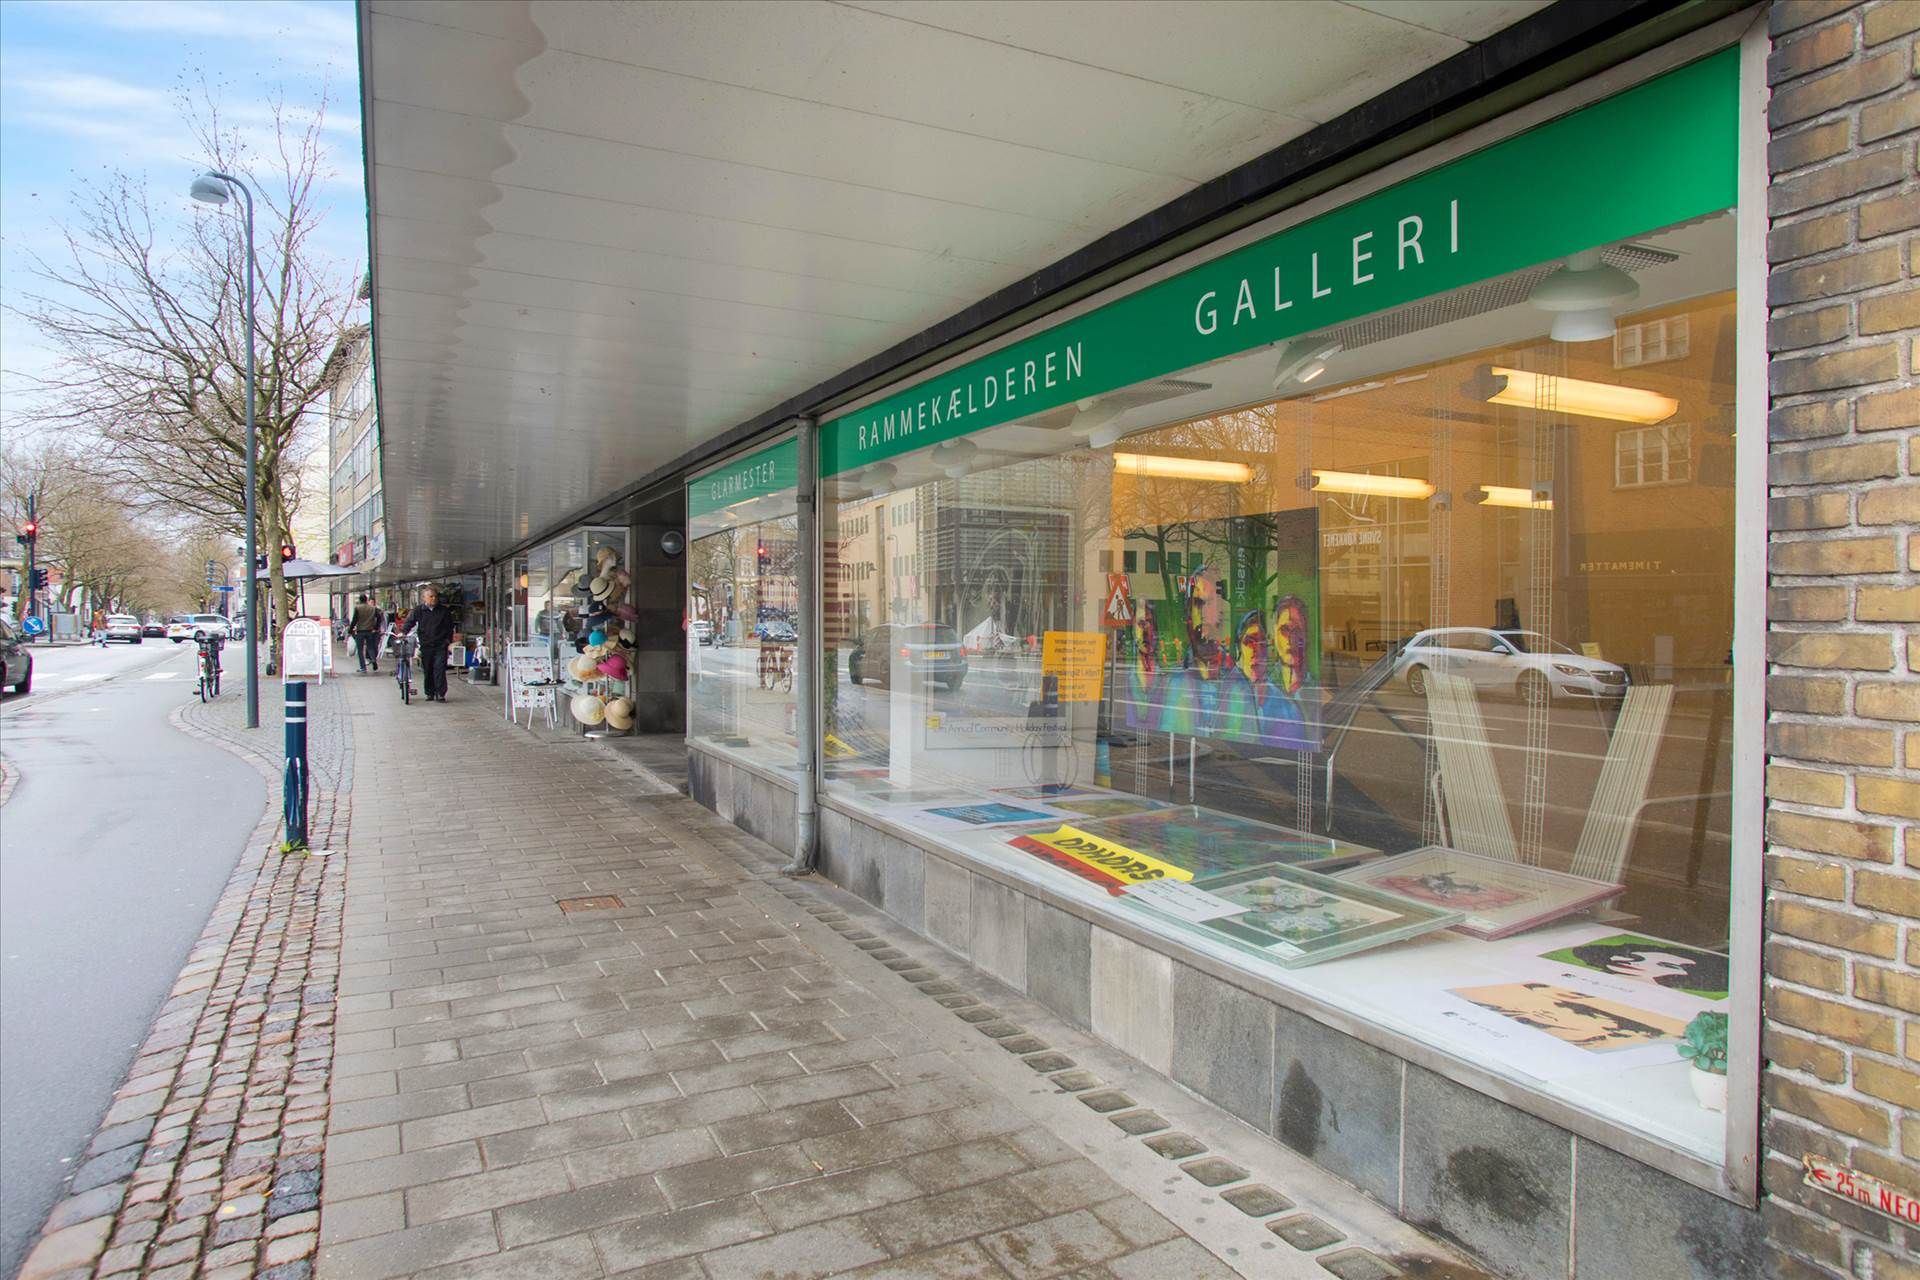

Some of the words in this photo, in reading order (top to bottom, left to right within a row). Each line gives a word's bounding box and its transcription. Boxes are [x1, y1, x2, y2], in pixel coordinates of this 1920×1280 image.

[858, 341, 1084, 451] RAMMEKÆLDEREN
[1194, 199, 1460, 336] GALLERI
[711, 460, 776, 501] GLARMESTER
